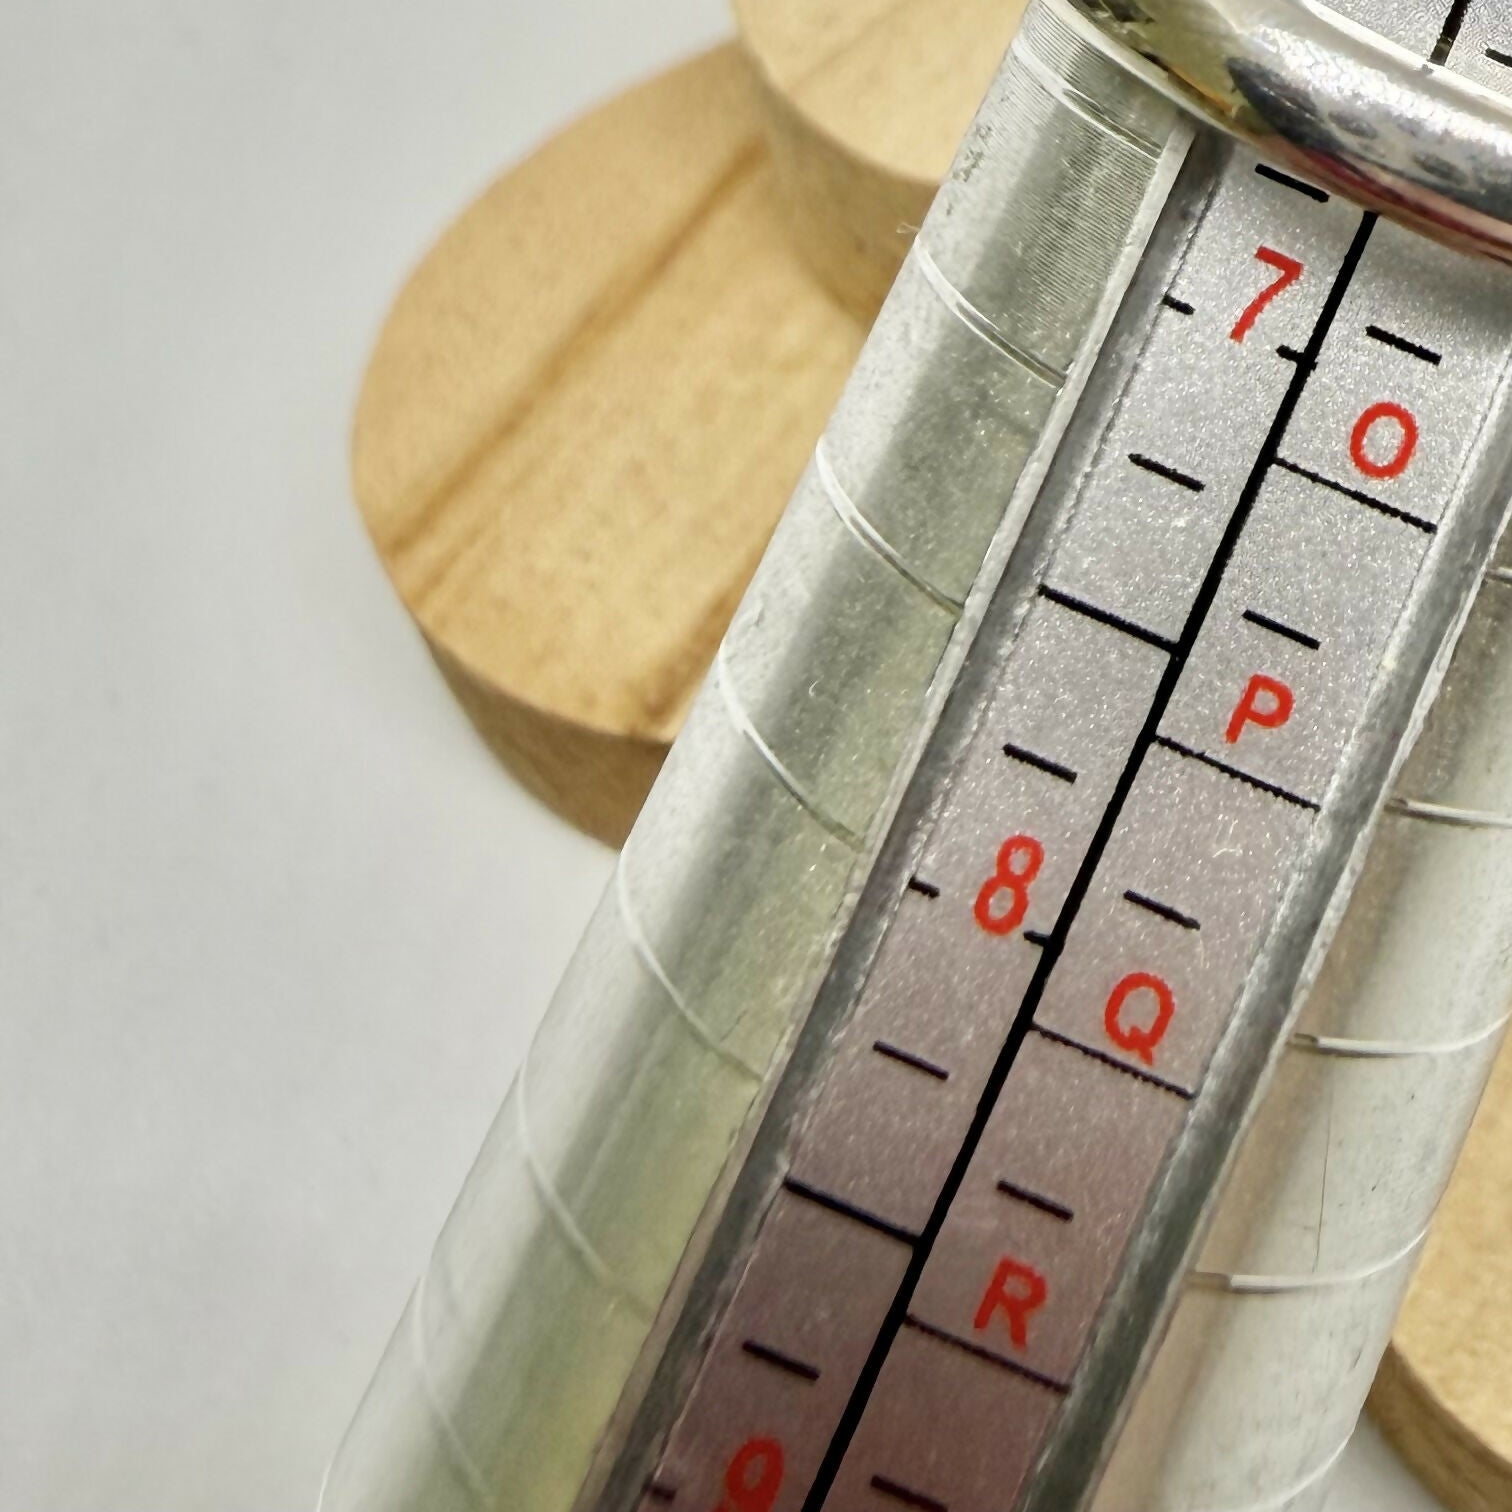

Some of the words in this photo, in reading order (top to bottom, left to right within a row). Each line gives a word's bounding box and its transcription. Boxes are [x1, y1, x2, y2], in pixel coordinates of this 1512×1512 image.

[1230, 247, 1304, 343] 7
[1349, 401, 1419, 480] O
[1224, 674, 1295, 744] P
[973, 835, 1045, 937] 8
[1103, 972, 1176, 1066] Q
[973, 1256, 1049, 1352] R
[711, 1434, 786, 1512] 9
